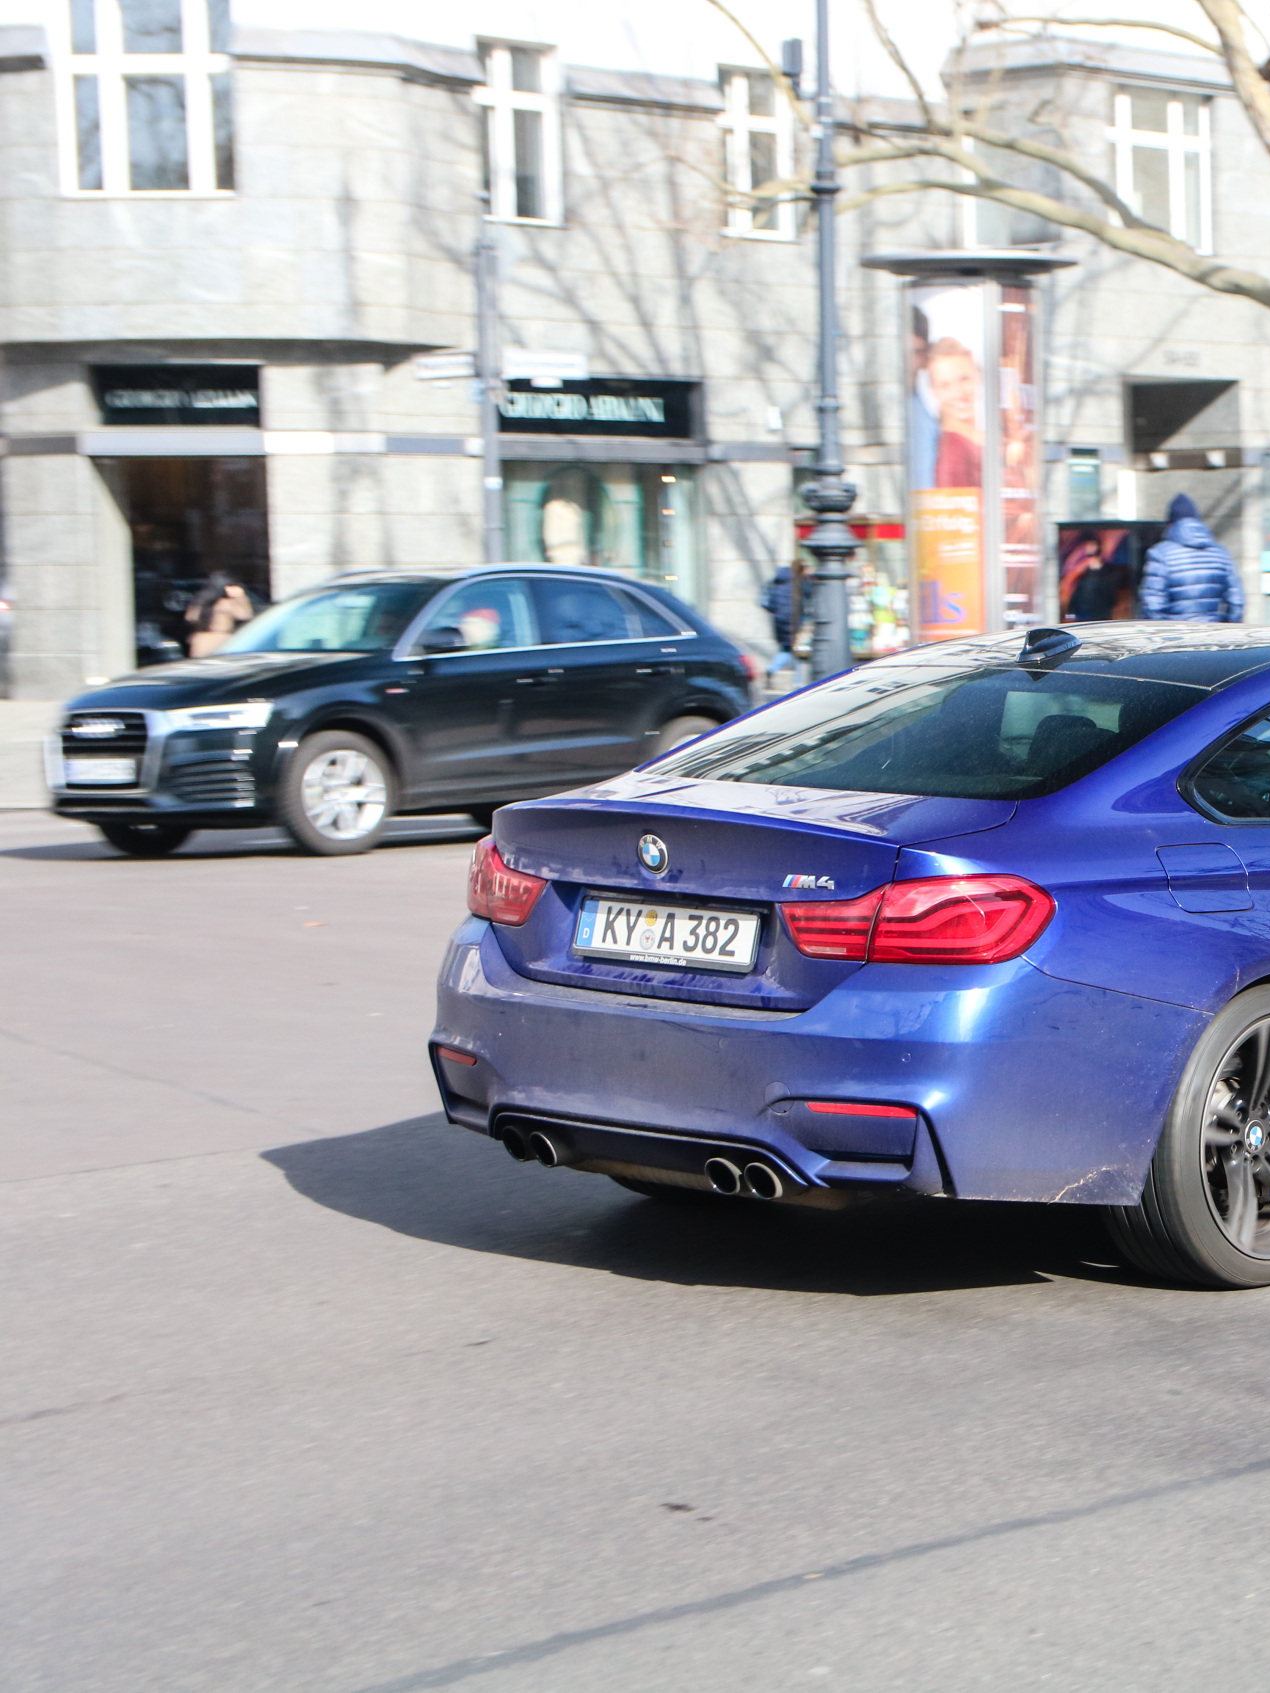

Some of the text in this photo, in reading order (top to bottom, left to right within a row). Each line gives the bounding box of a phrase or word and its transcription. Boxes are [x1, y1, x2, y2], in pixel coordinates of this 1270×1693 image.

[798, 874, 834, 890] M4
[601, 906, 740, 957] KY A 382
[629, 954, 687, 966] www.bmw-berlin.de
